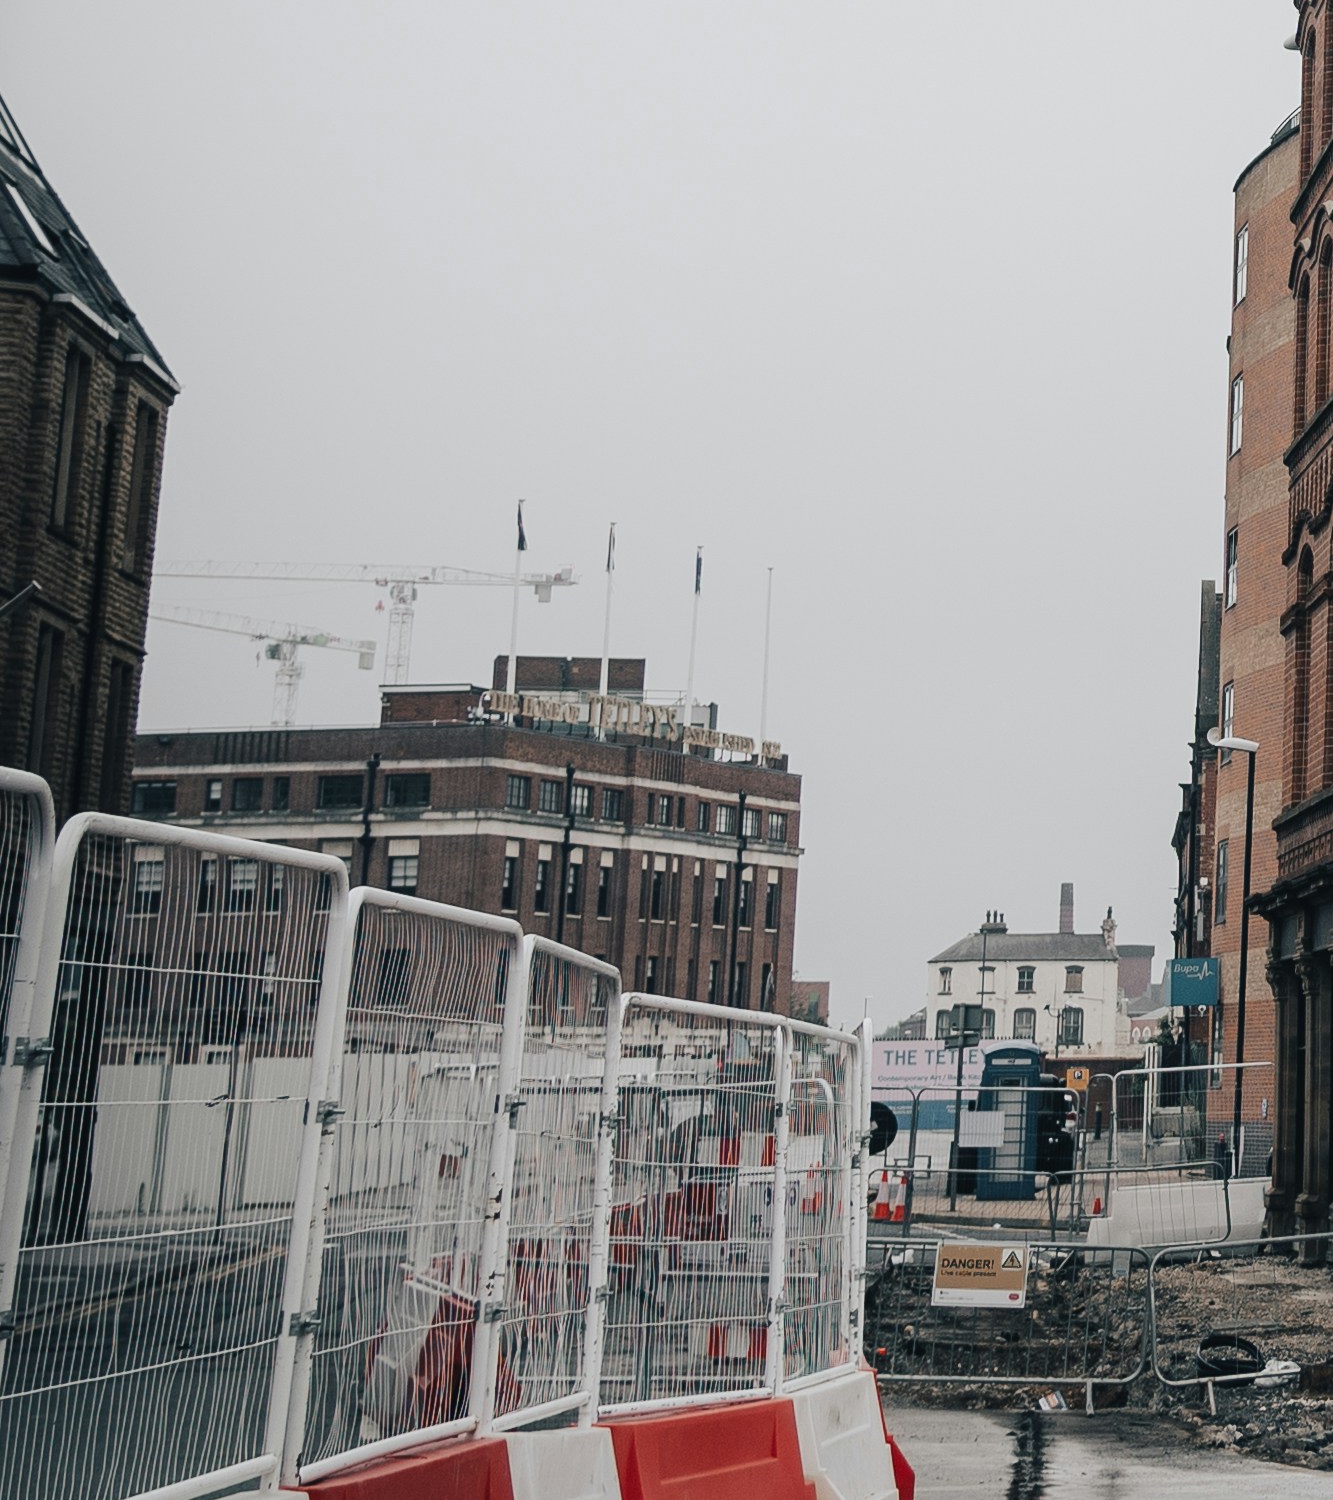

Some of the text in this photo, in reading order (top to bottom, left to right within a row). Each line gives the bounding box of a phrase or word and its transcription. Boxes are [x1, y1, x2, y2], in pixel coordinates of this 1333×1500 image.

[1173, 963, 1200, 975] Bupa
[883, 1049, 985, 1065] THE TETE
[942, 1258, 994, 1269] DANGER!
